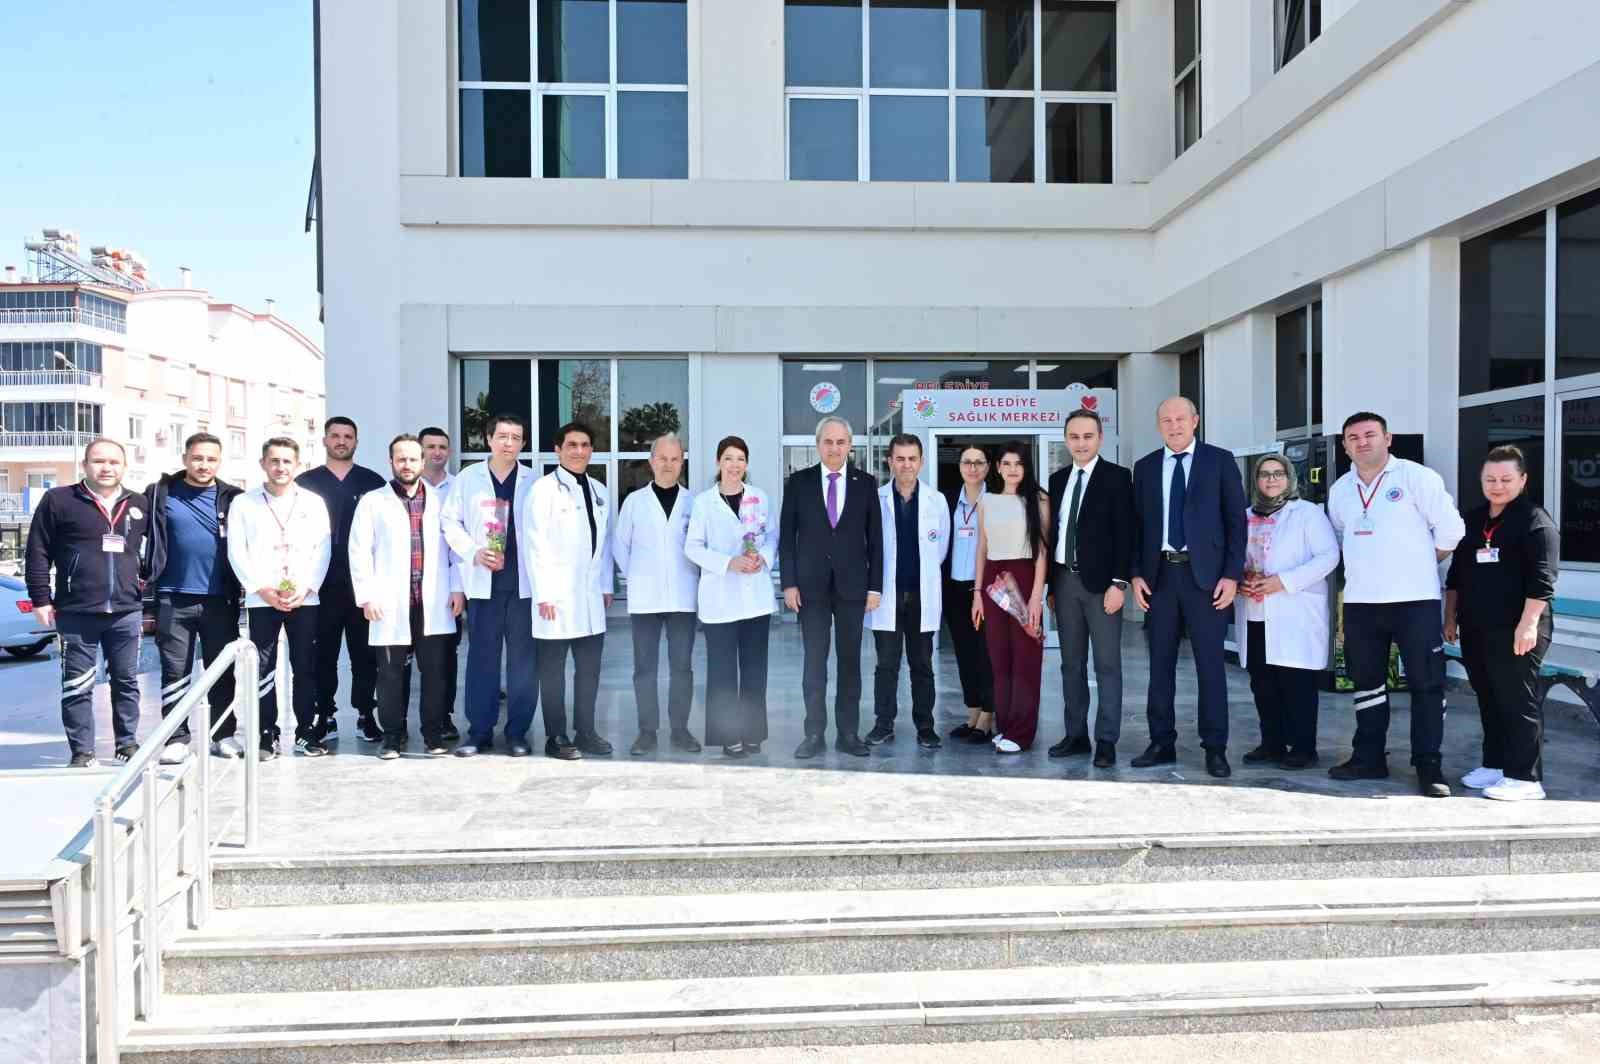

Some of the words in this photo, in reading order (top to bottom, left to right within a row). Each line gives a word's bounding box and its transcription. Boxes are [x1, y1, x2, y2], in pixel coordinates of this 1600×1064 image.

[973, 396, 1038, 407] BELEDİYE
[948, 410, 997, 422] SAĞLIK
[1001, 411, 1061, 422] MERKEZİ
